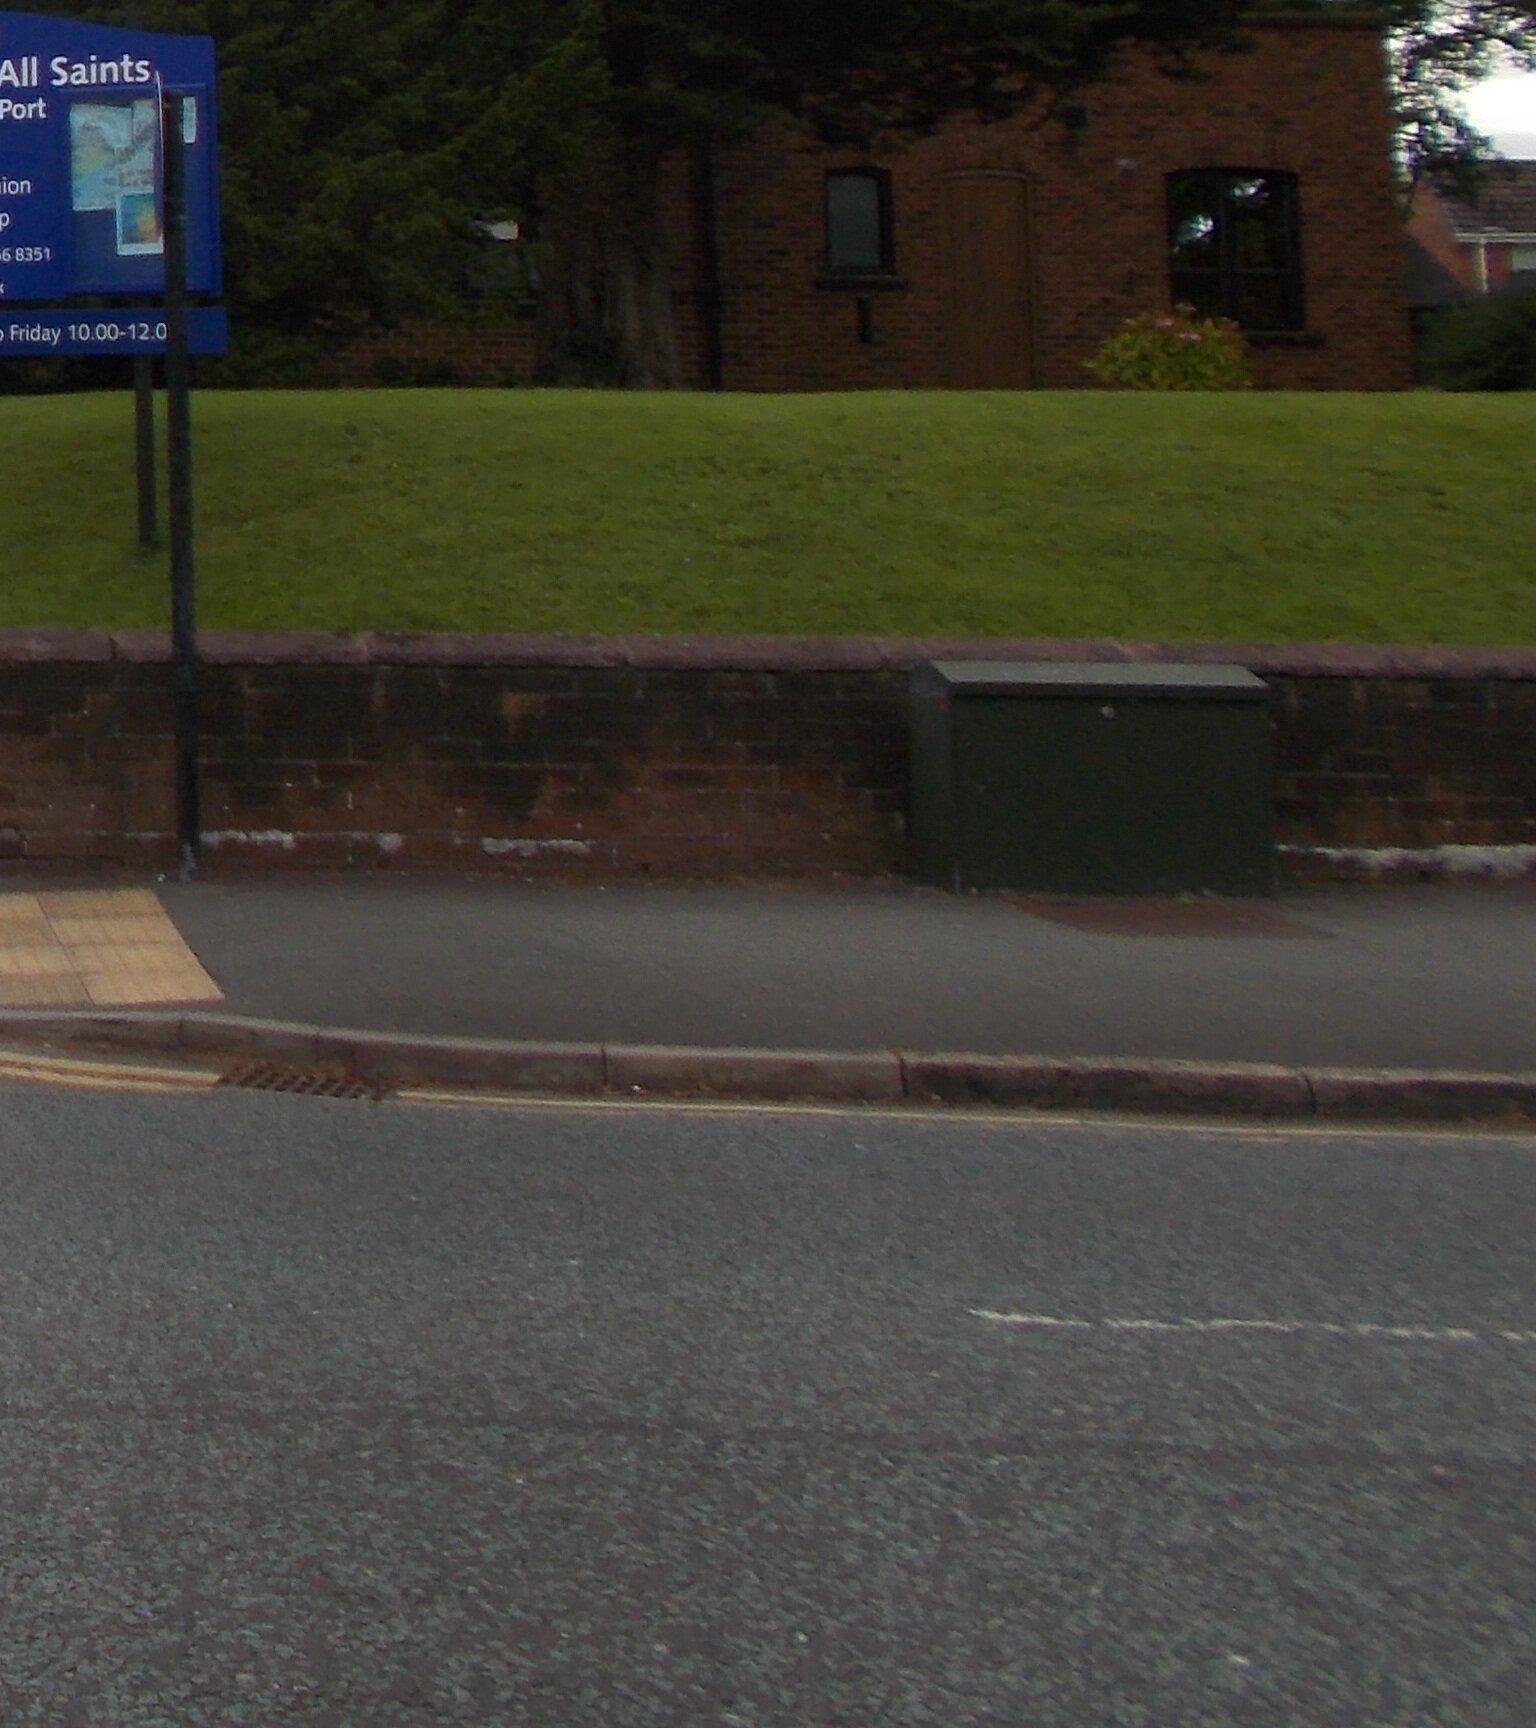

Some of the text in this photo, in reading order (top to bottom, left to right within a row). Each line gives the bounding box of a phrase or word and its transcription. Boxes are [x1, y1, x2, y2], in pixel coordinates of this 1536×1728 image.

[50, 53, 151, 86] Saints
[15, 247, 51, 262] 8351
[10, 324, 61, 345] Friday
[68, 322, 168, 341] 10.00-12.0
